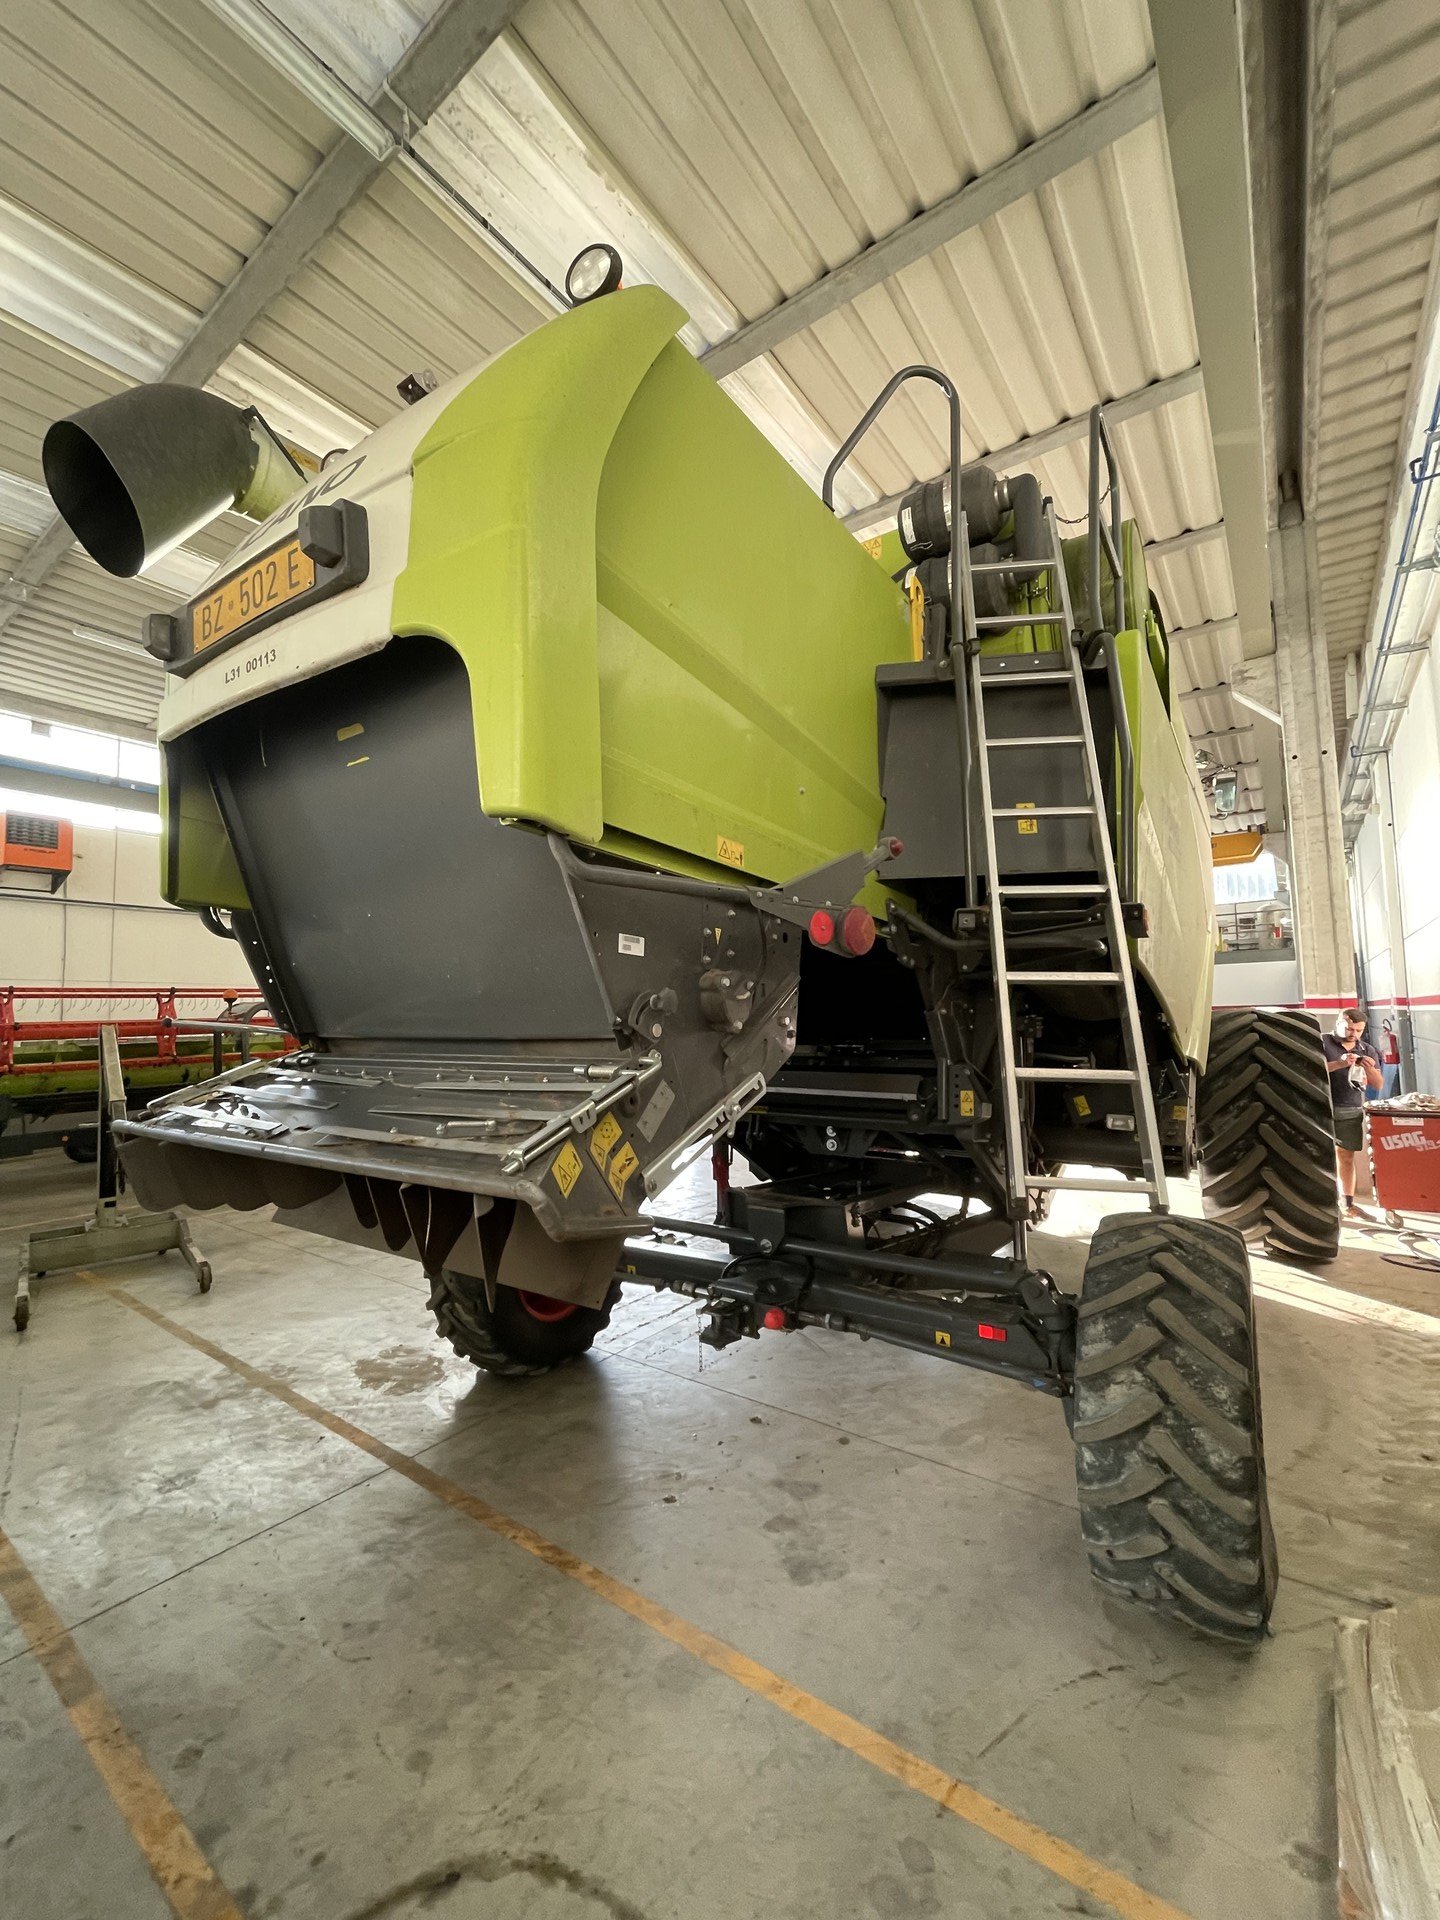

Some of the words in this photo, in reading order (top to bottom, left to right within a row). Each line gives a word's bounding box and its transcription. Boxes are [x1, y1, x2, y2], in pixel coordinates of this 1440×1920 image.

[202, 595, 223, 640] BZ
[240, 561, 278, 616] 502
[288, 547, 299, 589] E
[225, 665, 240, 684] L31
[245, 649, 276, 673] 00113
[1380, 1131, 1427, 1150] USAG
